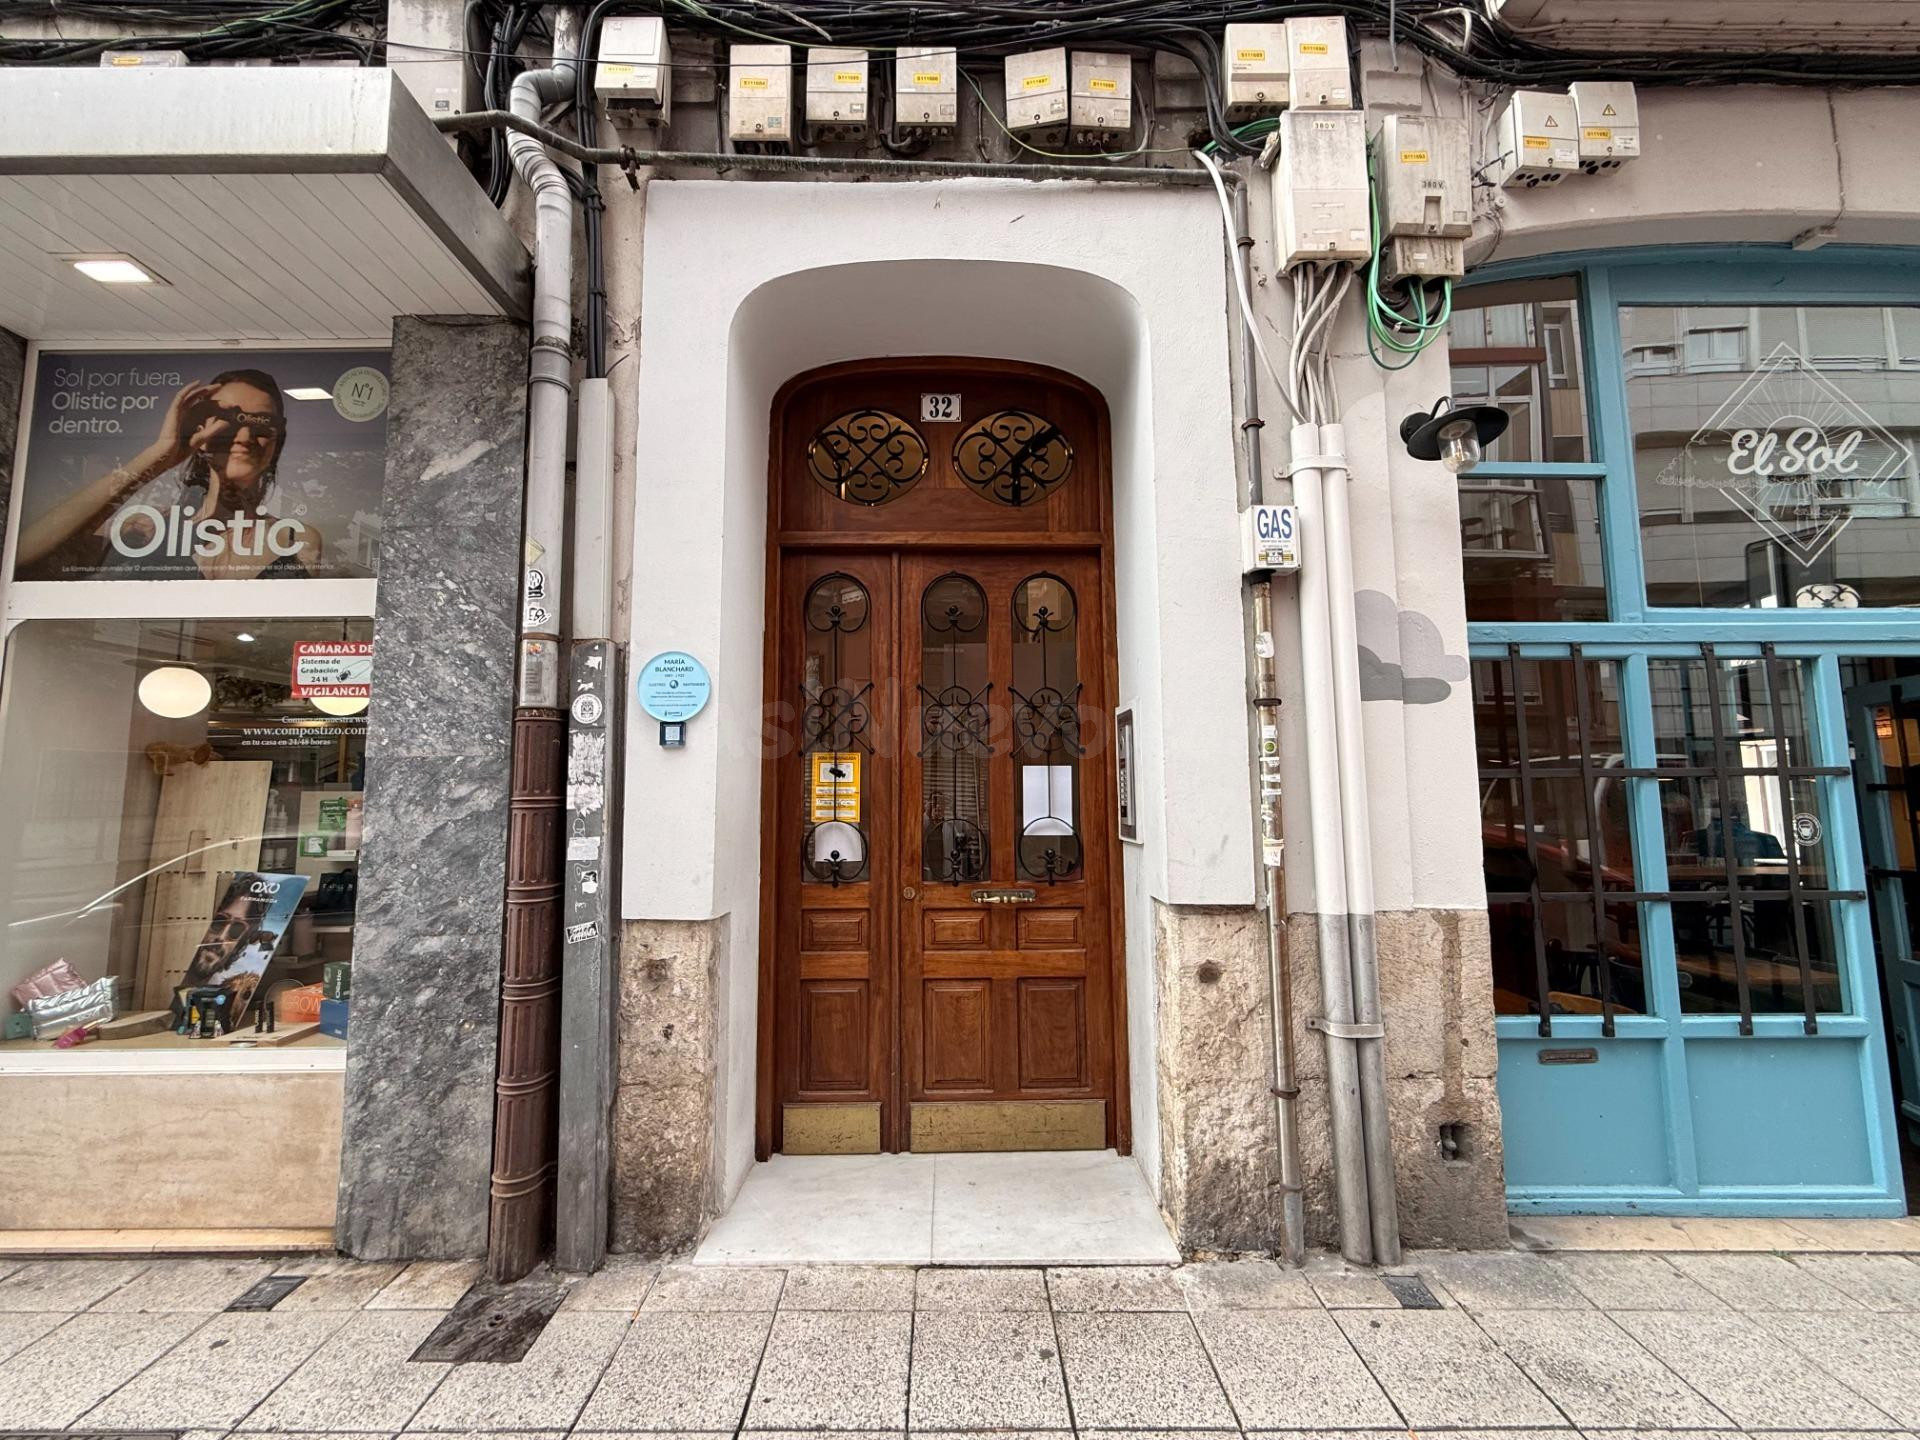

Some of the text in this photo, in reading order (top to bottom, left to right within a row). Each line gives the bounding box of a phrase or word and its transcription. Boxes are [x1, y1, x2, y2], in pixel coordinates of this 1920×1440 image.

[54, 368, 183, 390] Sol por fuera.
[52, 391, 159, 415] Olistic por
[929, 396, 953, 419] 32
[49, 415, 123, 435] dentro.
[236, 412, 271, 426] Olistic
[1727, 427, 1863, 476] El Sol
[110, 503, 305, 558] Olistic
[1257, 508, 1292, 539] GAS
[299, 644, 374, 654] CAMARAS DE
[300, 687, 368, 696] VIGILANCIA
[243, 726, 368, 738] www.compostizo.com
[310, 738, 331, 746] horas
